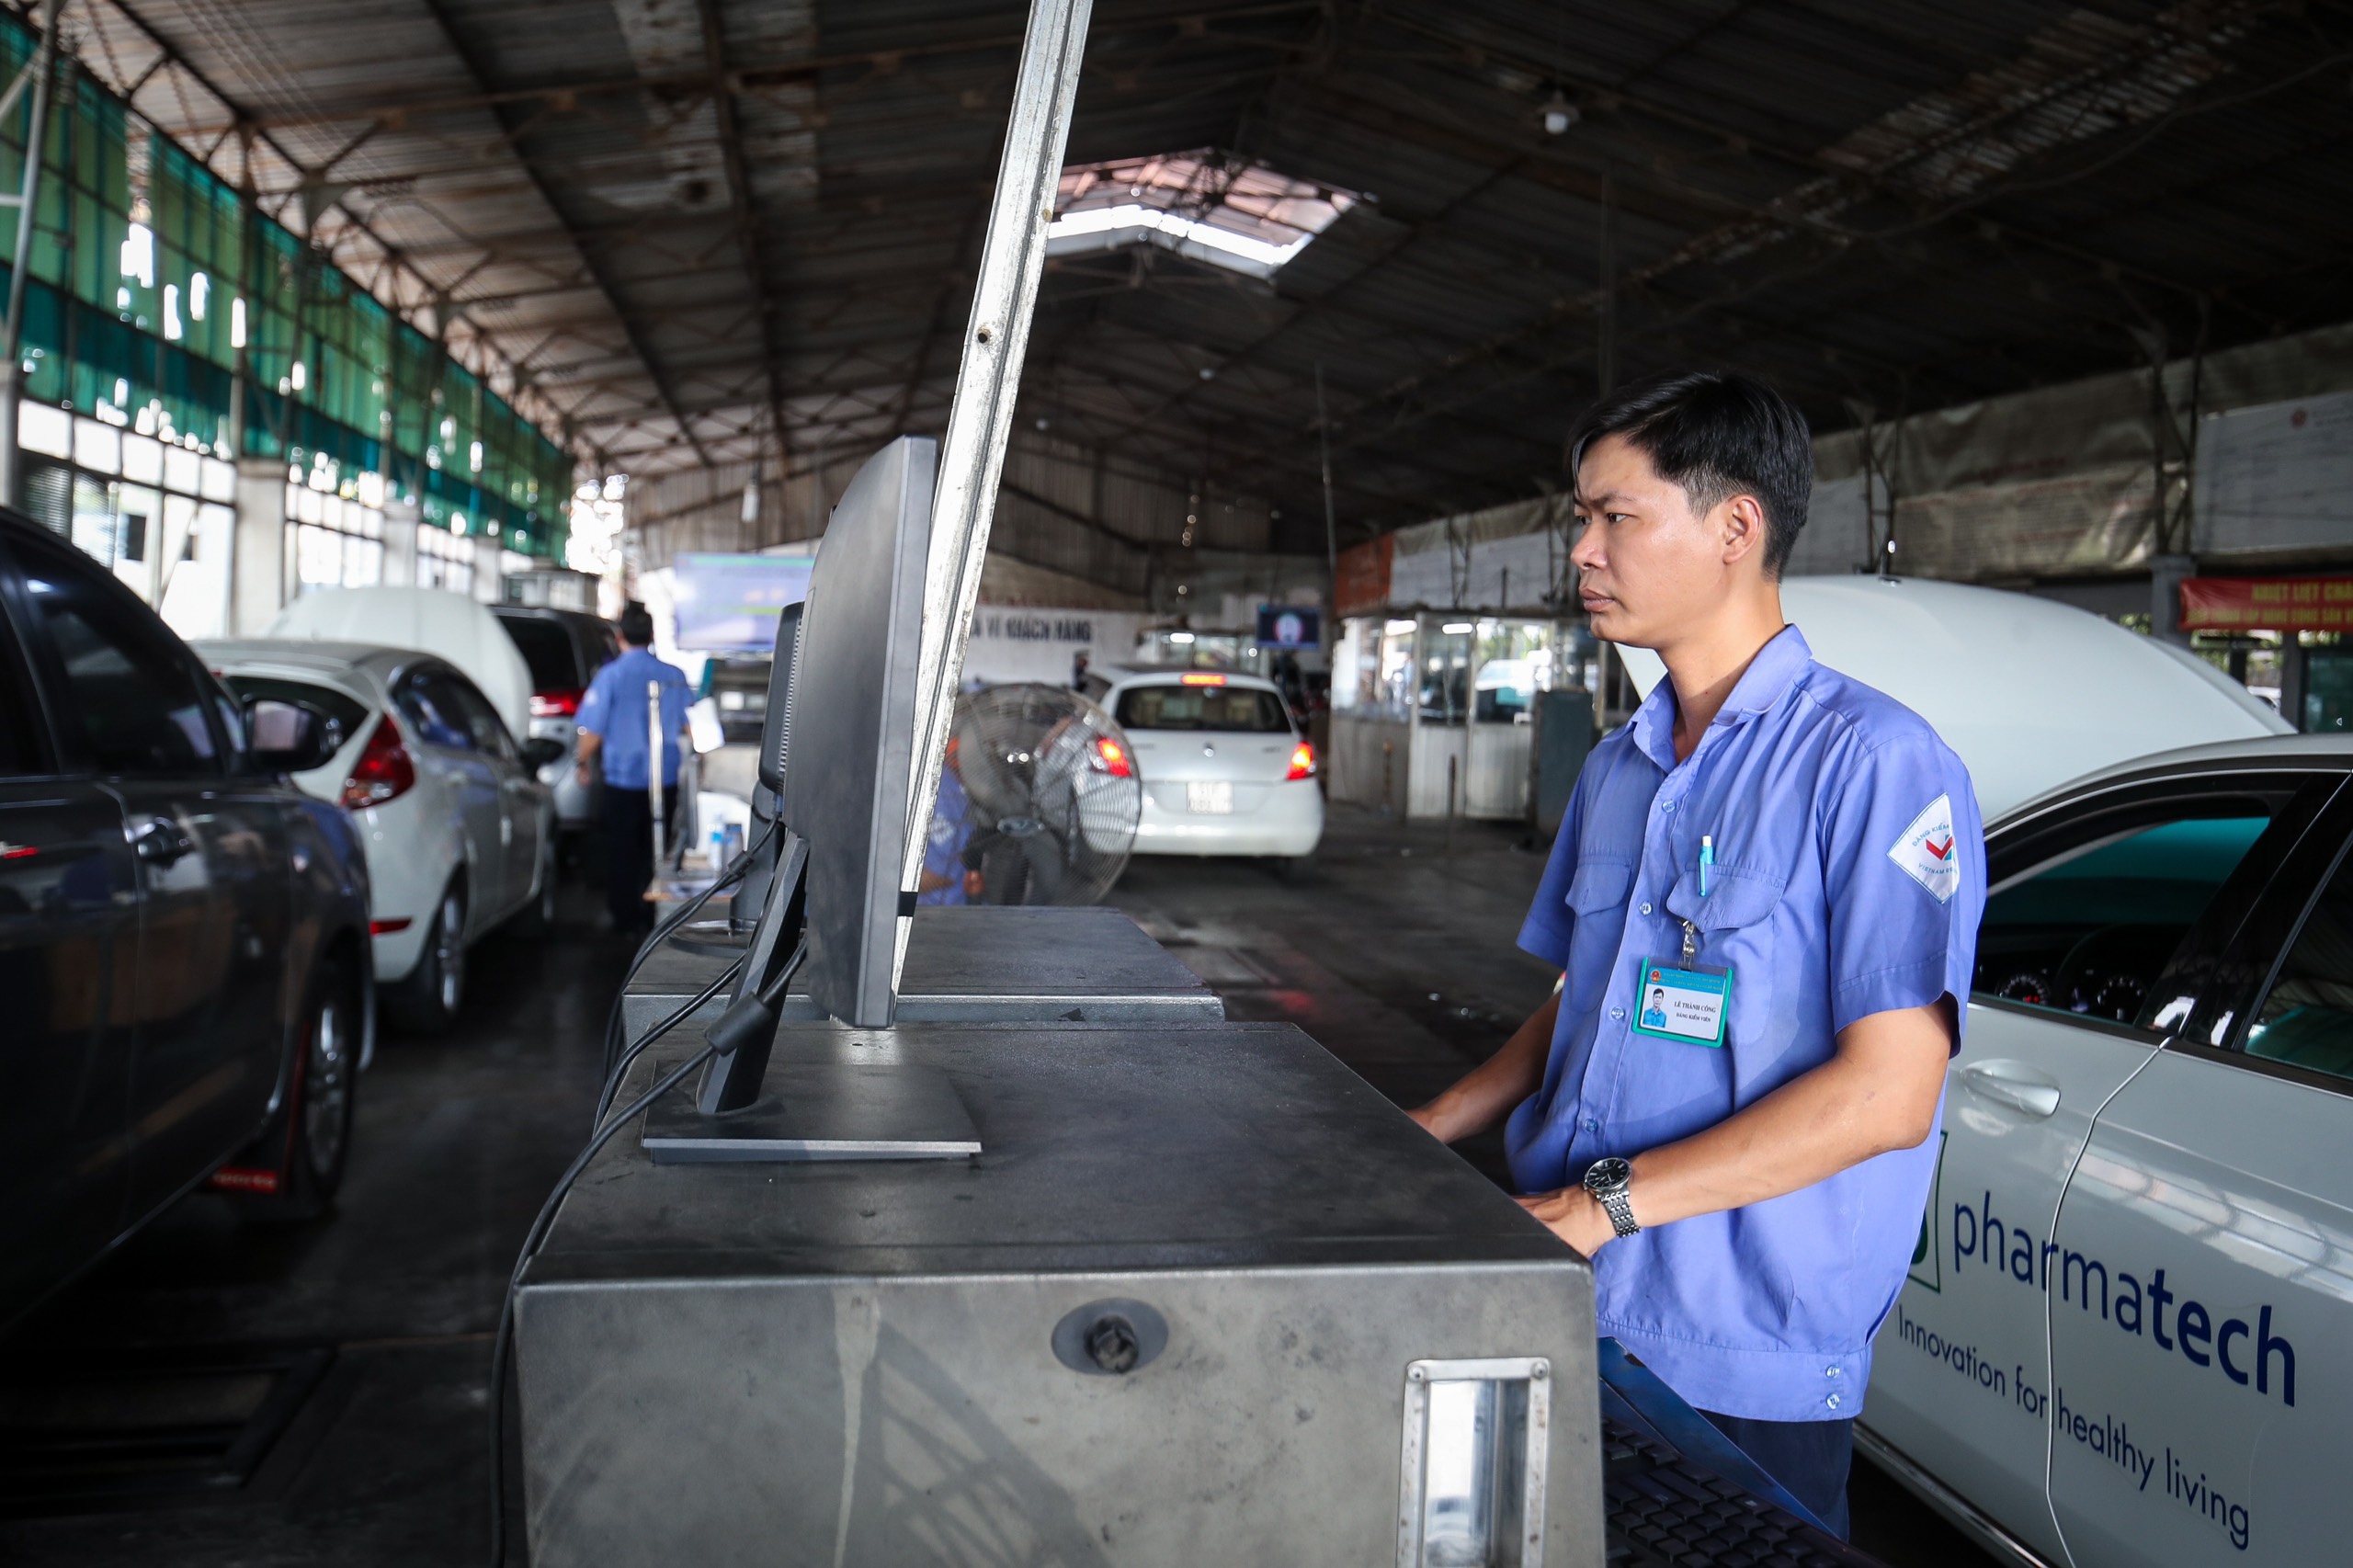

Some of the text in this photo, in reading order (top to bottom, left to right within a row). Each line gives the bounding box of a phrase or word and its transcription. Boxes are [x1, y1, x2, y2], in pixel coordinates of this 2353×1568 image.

[1954, 1190, 2296, 1408] pharmatech
[1897, 1303, 2249, 1551] Innovation for healthy living
